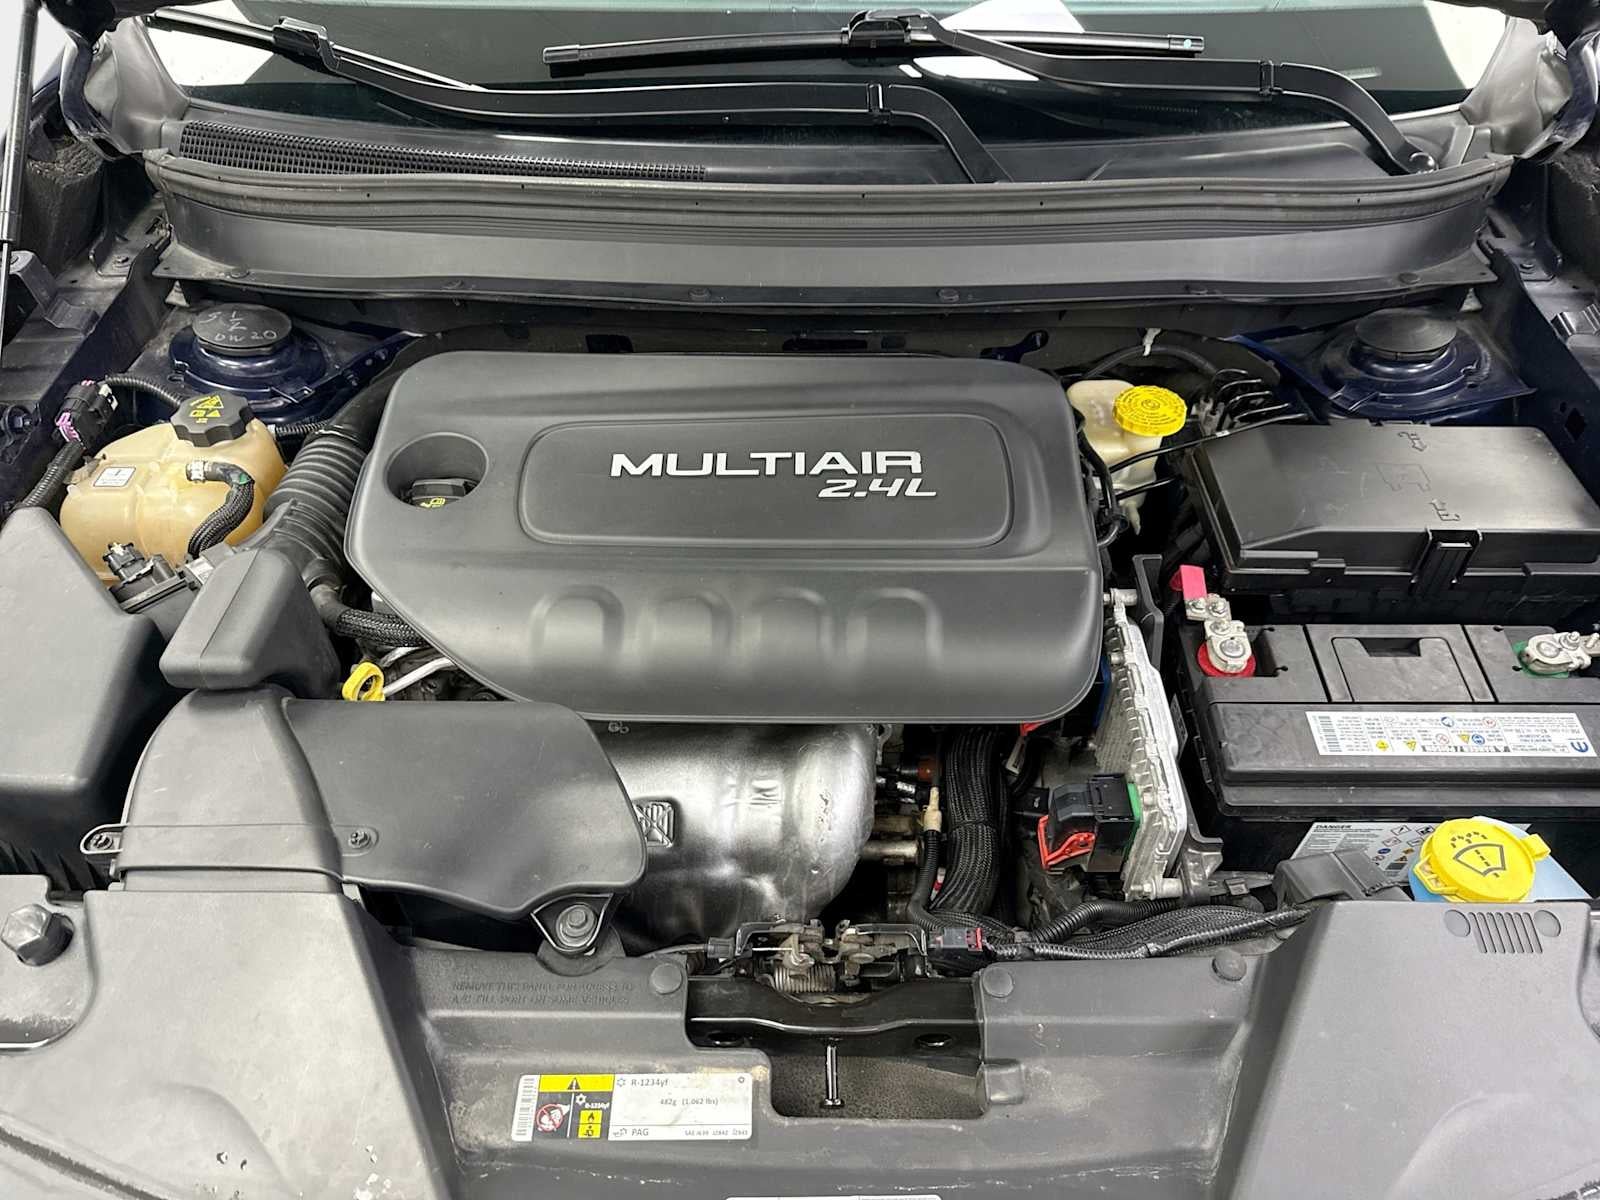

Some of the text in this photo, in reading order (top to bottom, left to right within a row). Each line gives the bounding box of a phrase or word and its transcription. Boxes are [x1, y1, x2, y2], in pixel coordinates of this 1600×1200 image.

[610, 451, 922, 477] MULTIAIR
[817, 478, 937, 498] 2.4L
[631, 1078, 669, 1087] R-1234yf
[631, 1128, 649, 1137] PAG
